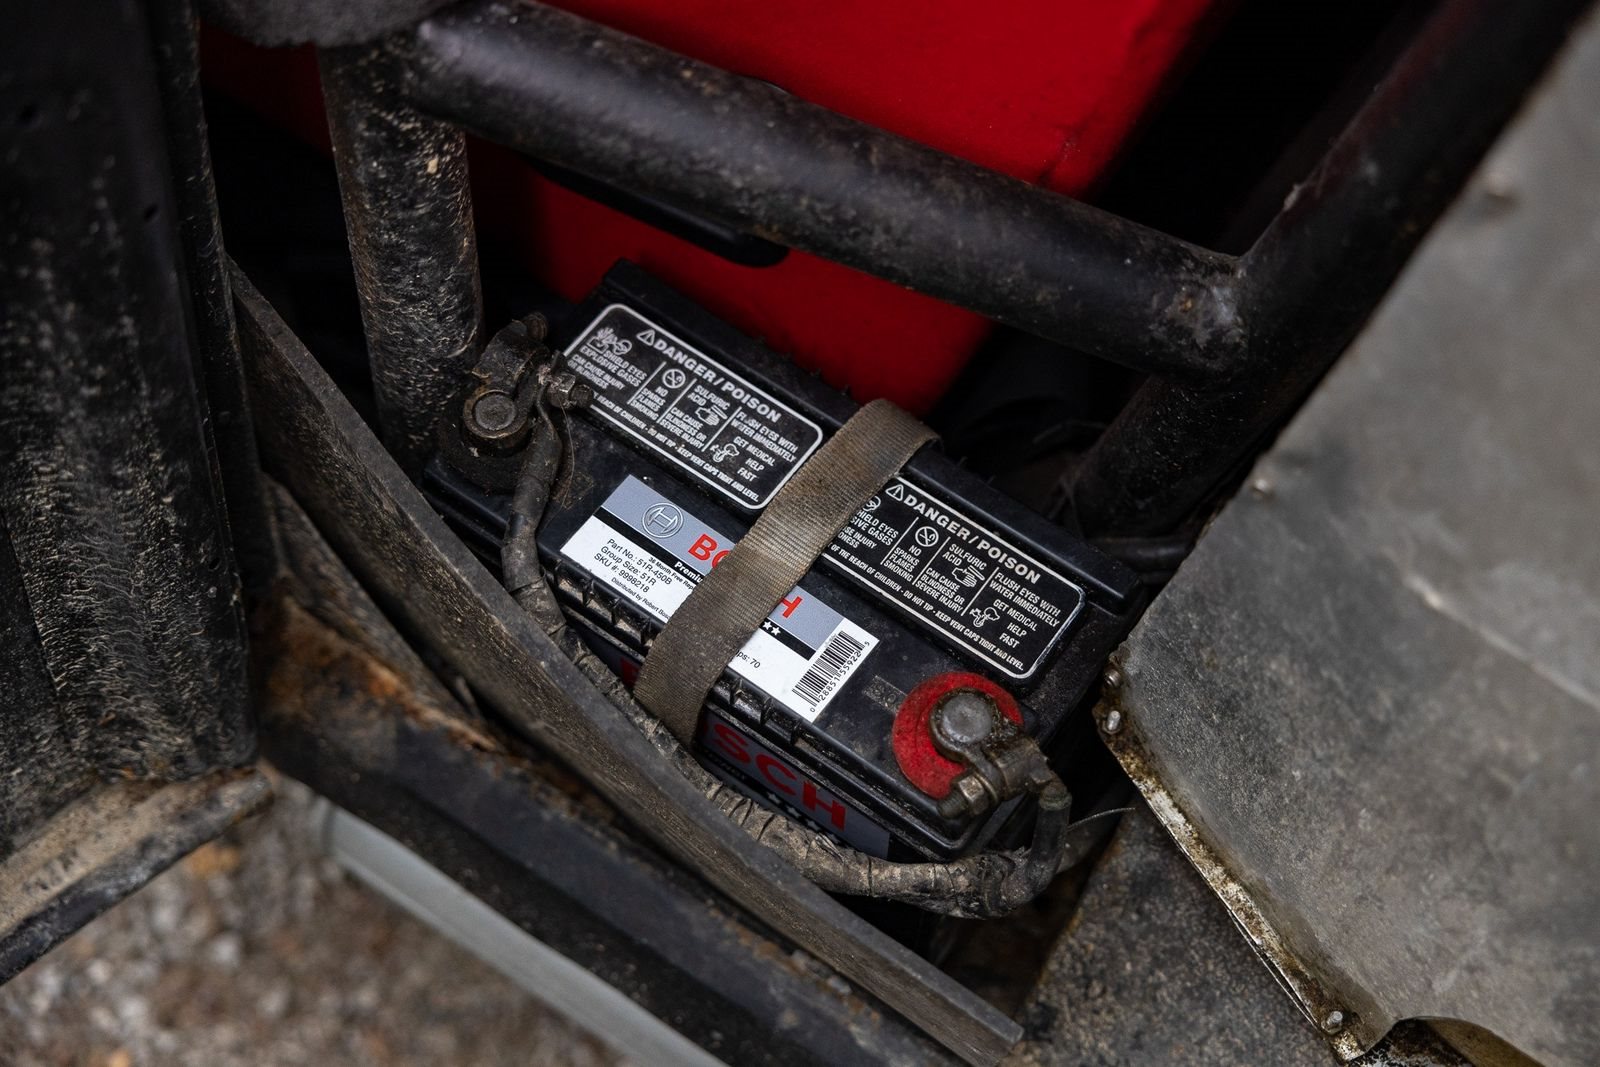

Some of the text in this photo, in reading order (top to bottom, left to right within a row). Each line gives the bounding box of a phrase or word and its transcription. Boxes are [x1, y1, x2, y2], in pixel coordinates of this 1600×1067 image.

[572, 354, 586, 366] CAN
[580, 345, 641, 387] EXPLOSIVE GASES
[603, 350, 647, 380] SHIELD EYES
[634, 394, 660, 412] FLAMES
[640, 388, 666, 406] SPARKS
[655, 386, 668, 397] NO
[687, 392, 707, 406] ACID
[694, 385, 730, 410] SULFURIC
[630, 398, 659, 420] SMOKING
[670, 407, 703, 430] CAN CAUSE
[659, 419, 704, 449] SEVERE INJURY
[665, 413, 707, 442] BLINDNESS OR
[759, 426, 780, 441] EYES
[778, 437, 798, 453] WITH
[677, 446, 692, 458] KEEP
[733, 436, 775, 466] GET MEDICAL
[752, 433, 796, 462] IMMEDIATELY
[737, 467, 757, 482] FAST
[745, 458, 765, 471] HELP
[856, 510, 899, 539] HIELD EYES
[868, 527, 893, 546] GASES
[853, 532, 877, 549] INJURY
[908, 545, 922, 556] NO
[601, 546, 657, 586] Group Size: 51R
[607, 538, 672, 585] Part No.: 51R-450B
[889, 553, 915, 572] FLAMES
[894, 547, 920, 566] SPARKS
[942, 551, 962, 566] ACID
[949, 543, 987, 570] SULFURIC
[594, 553, 613, 567] SKU
[618, 569, 650, 593] 9998218
[655, 561, 672, 575] Month
[671, 572, 683, 583] Free
[682, 580, 694, 591] Rep
[674, 561, 703, 583] Premiu
[883, 560, 914, 582] SMOKING
[926, 567, 960, 592] CAN CAUSE
[611, 577, 670, 619] Distributed by Robert Bosc
[915, 580, 963, 613] SEVERE INJURY
[920, 574, 965, 605] BLINDNESS OR
[994, 572, 1061, 617] FLUSH EYES WITH
[831, 544, 840, 552] OF
[838, 549, 851, 559] THE
[848, 555, 868, 570] REACH
[866, 567, 876, 575] OF
[874, 571, 902, 592] CHILDREN
[903, 590, 913, 599] DO
[911, 595, 925, 606] NOT
[923, 602, 934, 611] TIP
[935, 610, 951, 622] KEEP
[950, 619, 966, 632] VENT
[963, 628, 980, 642] CAPS
[978, 637, 996, 652] TIGHT
[993, 648, 1008, 659] AND
[1006, 655, 1023, 671] LEVEL.
[989, 580, 1060, 627] WATER IMMEDIATELY
[993, 599, 1037, 631] GET MEDICAL
[999, 633, 1020, 648] FAST
[1007, 622, 1027, 637] HELP
[750, 658, 761, 668] 70
[818, 677, 840, 701] 28851
[839, 651, 861, 676] 55922
